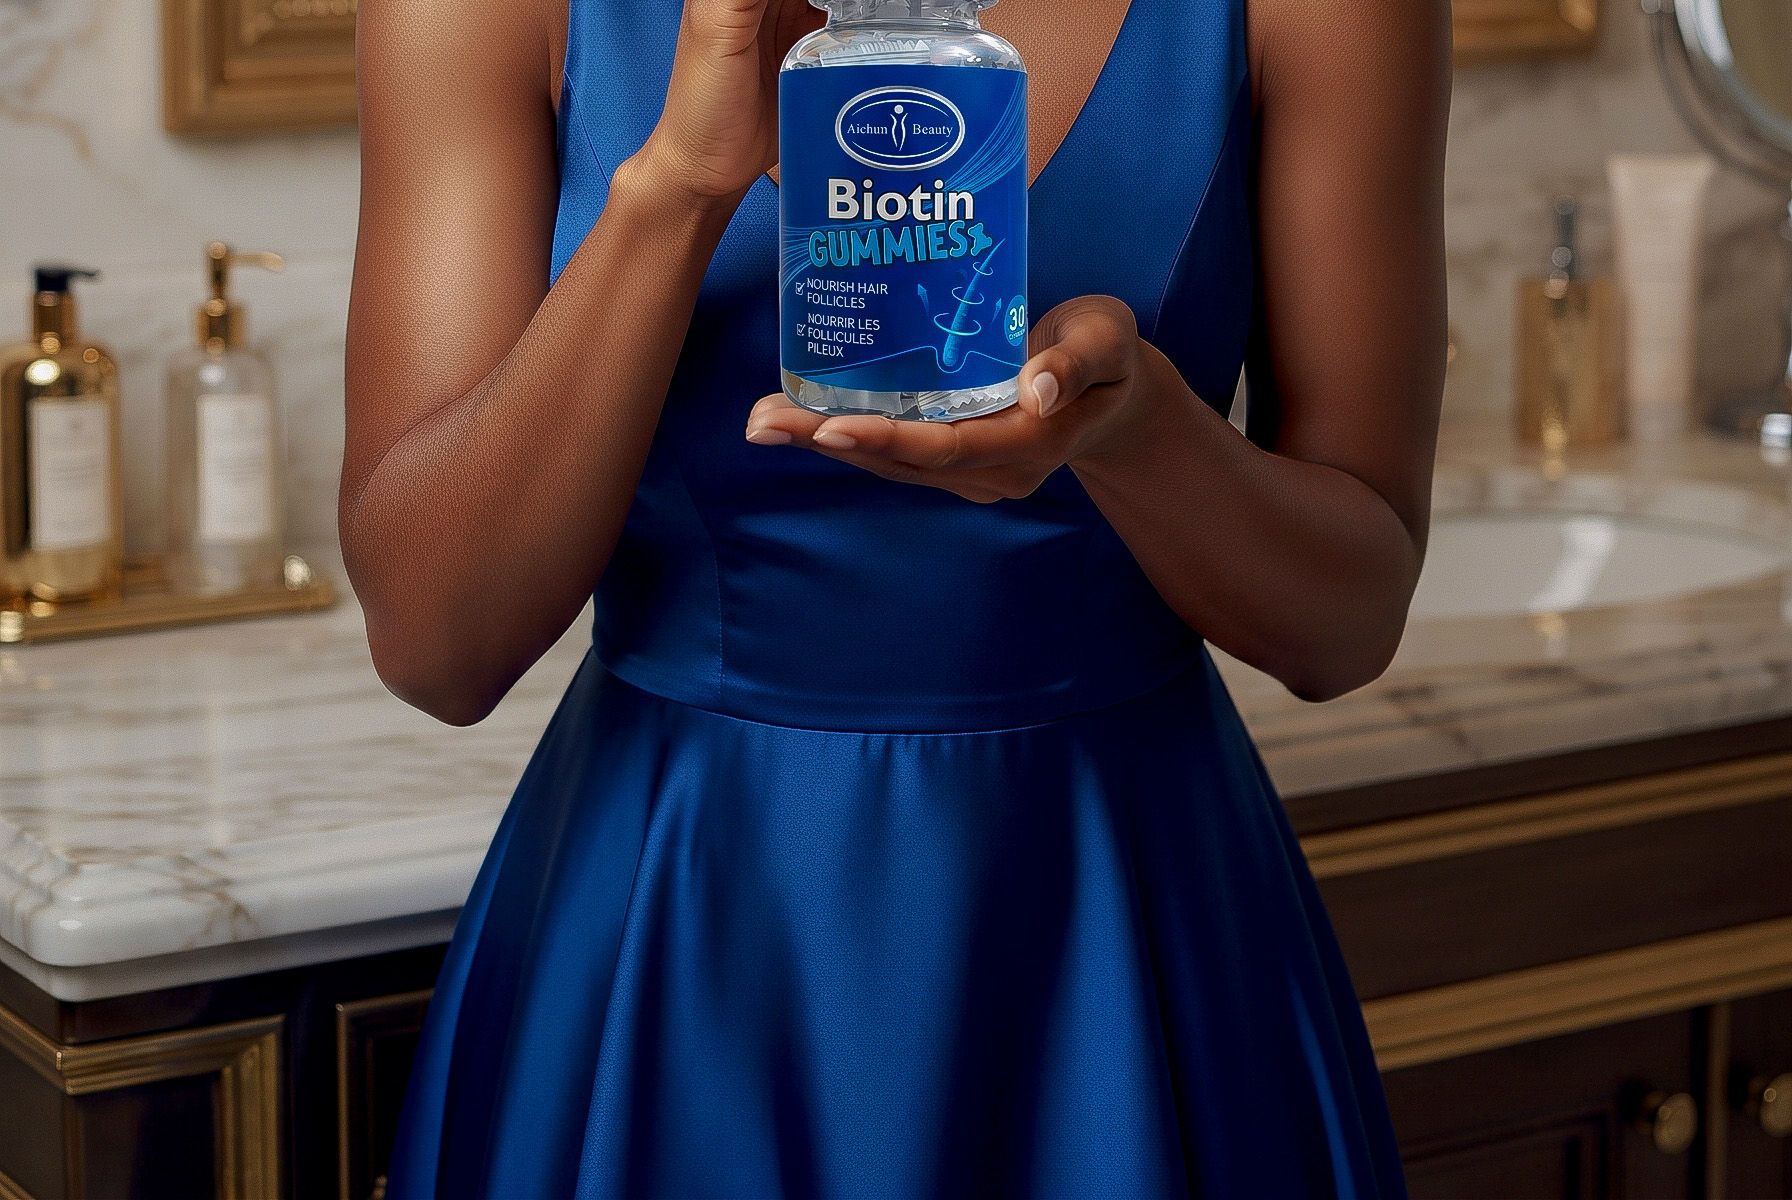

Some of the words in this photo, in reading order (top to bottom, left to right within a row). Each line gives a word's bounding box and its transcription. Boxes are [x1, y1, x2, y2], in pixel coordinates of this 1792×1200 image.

[847, 123, 888, 135] Aichun
[912, 123, 953, 138] Beauty
[828, 178, 974, 221] Biotin
[808, 220, 968, 268] GUMMIES
[807, 277, 855, 293] NOURISH
[858, 282, 888, 295] HAIR
[807, 292, 866, 309] FOLLICLES
[807, 312, 855, 329] NOURRIR
[858, 318, 881, 331] LES
[1009, 304, 1025, 331] 30
[807, 327, 874, 345] FOLLICULES
[807, 341, 844, 358] PILEUX
